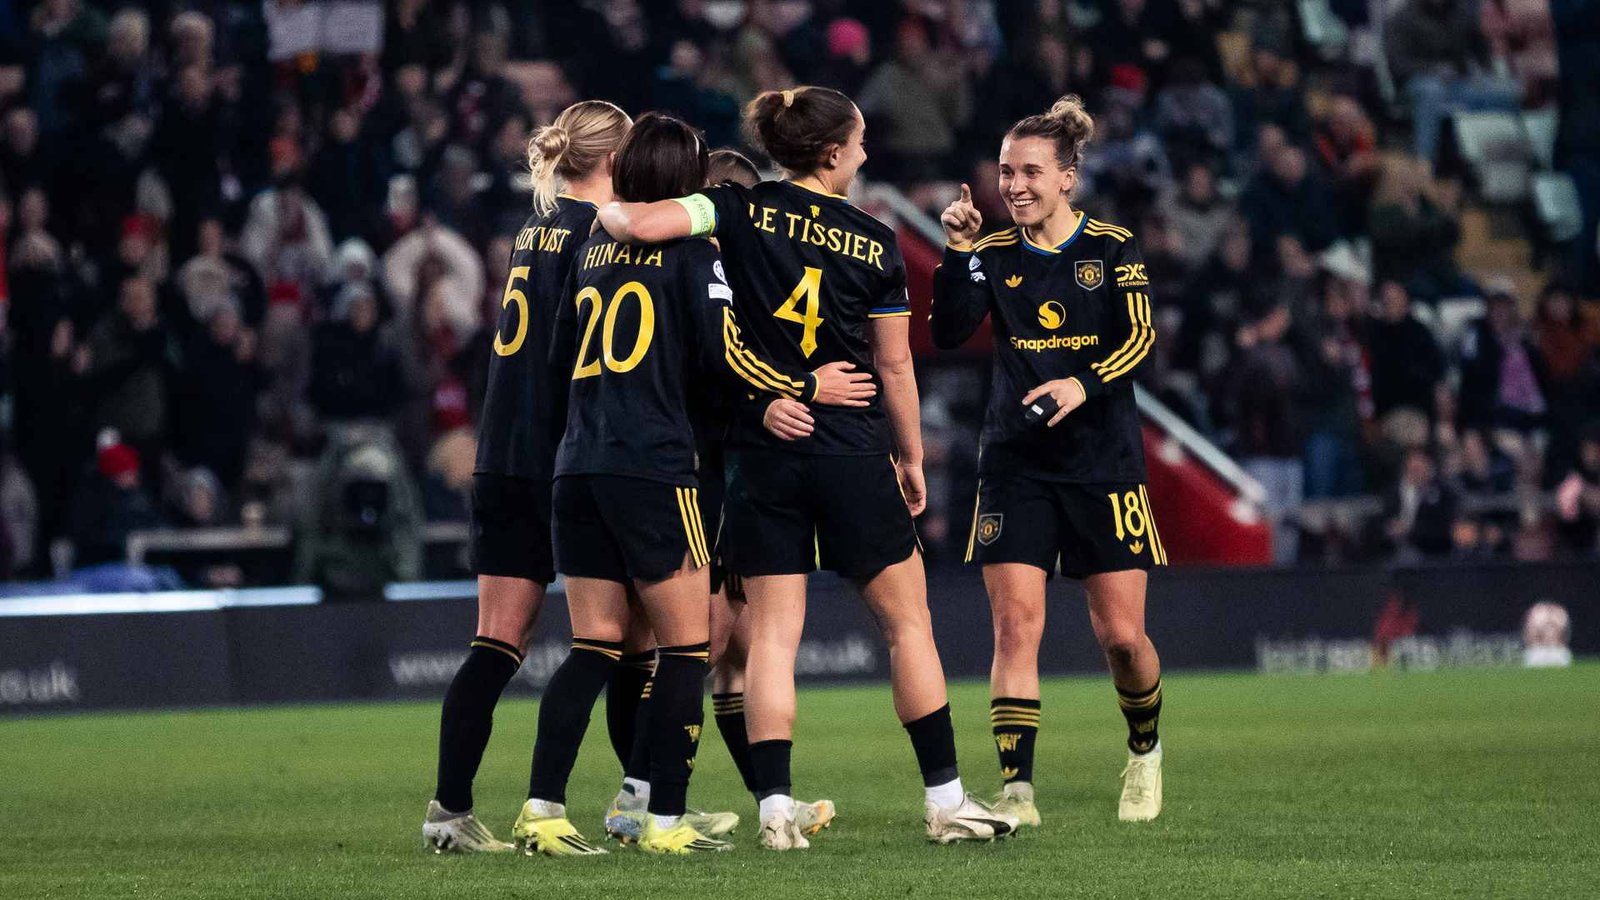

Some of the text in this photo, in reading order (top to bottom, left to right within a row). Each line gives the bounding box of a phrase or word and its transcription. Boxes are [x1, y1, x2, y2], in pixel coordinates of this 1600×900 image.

[785, 212, 885, 271] TISSIER
[493, 266, 531, 357] 5
[571, 281, 655, 381] 20
[772, 266, 825, 359] 4
[1009, 334, 1099, 353] Snapdragon
[1107, 490, 1146, 541] 18
